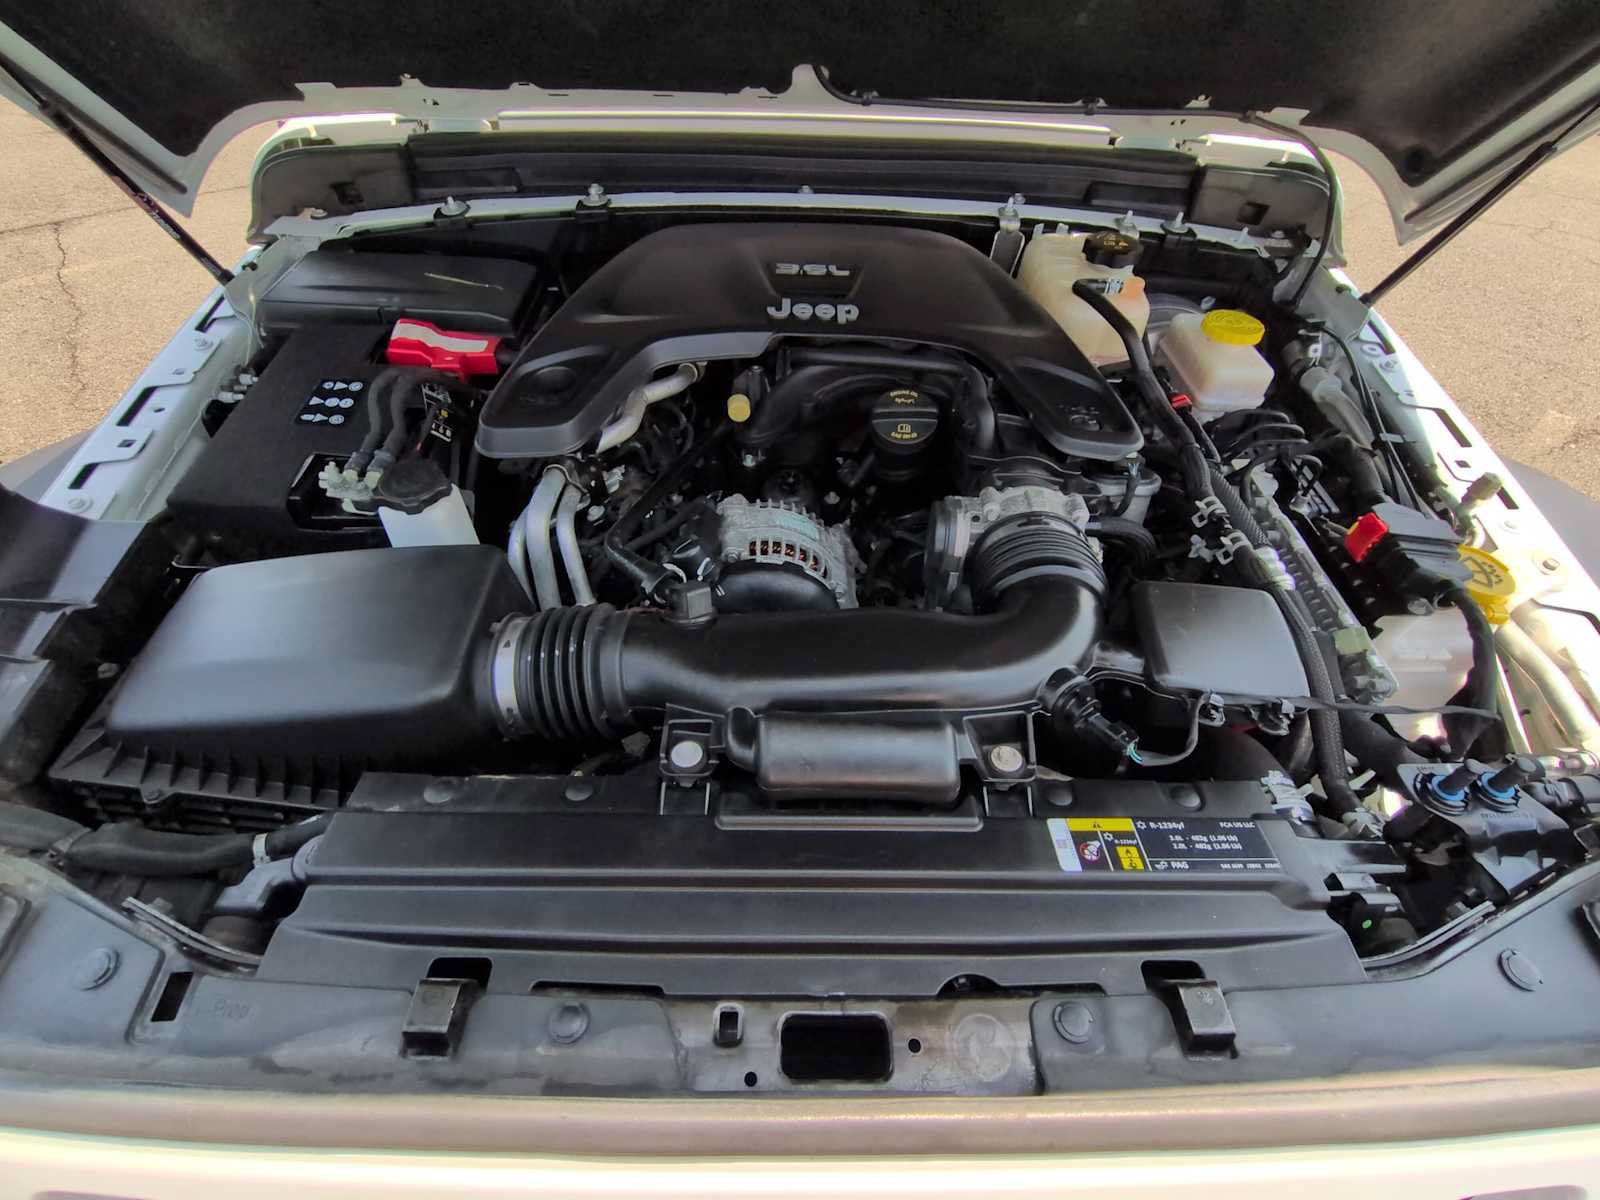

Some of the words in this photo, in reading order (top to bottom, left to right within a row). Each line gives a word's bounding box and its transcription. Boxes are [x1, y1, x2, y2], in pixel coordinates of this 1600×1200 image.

[775, 263, 850, 276] 3.6L
[766, 298, 860, 324] Jeep
[1149, 821, 1185, 830] R-1234yf
[1170, 861, 1189, 869] PAG
